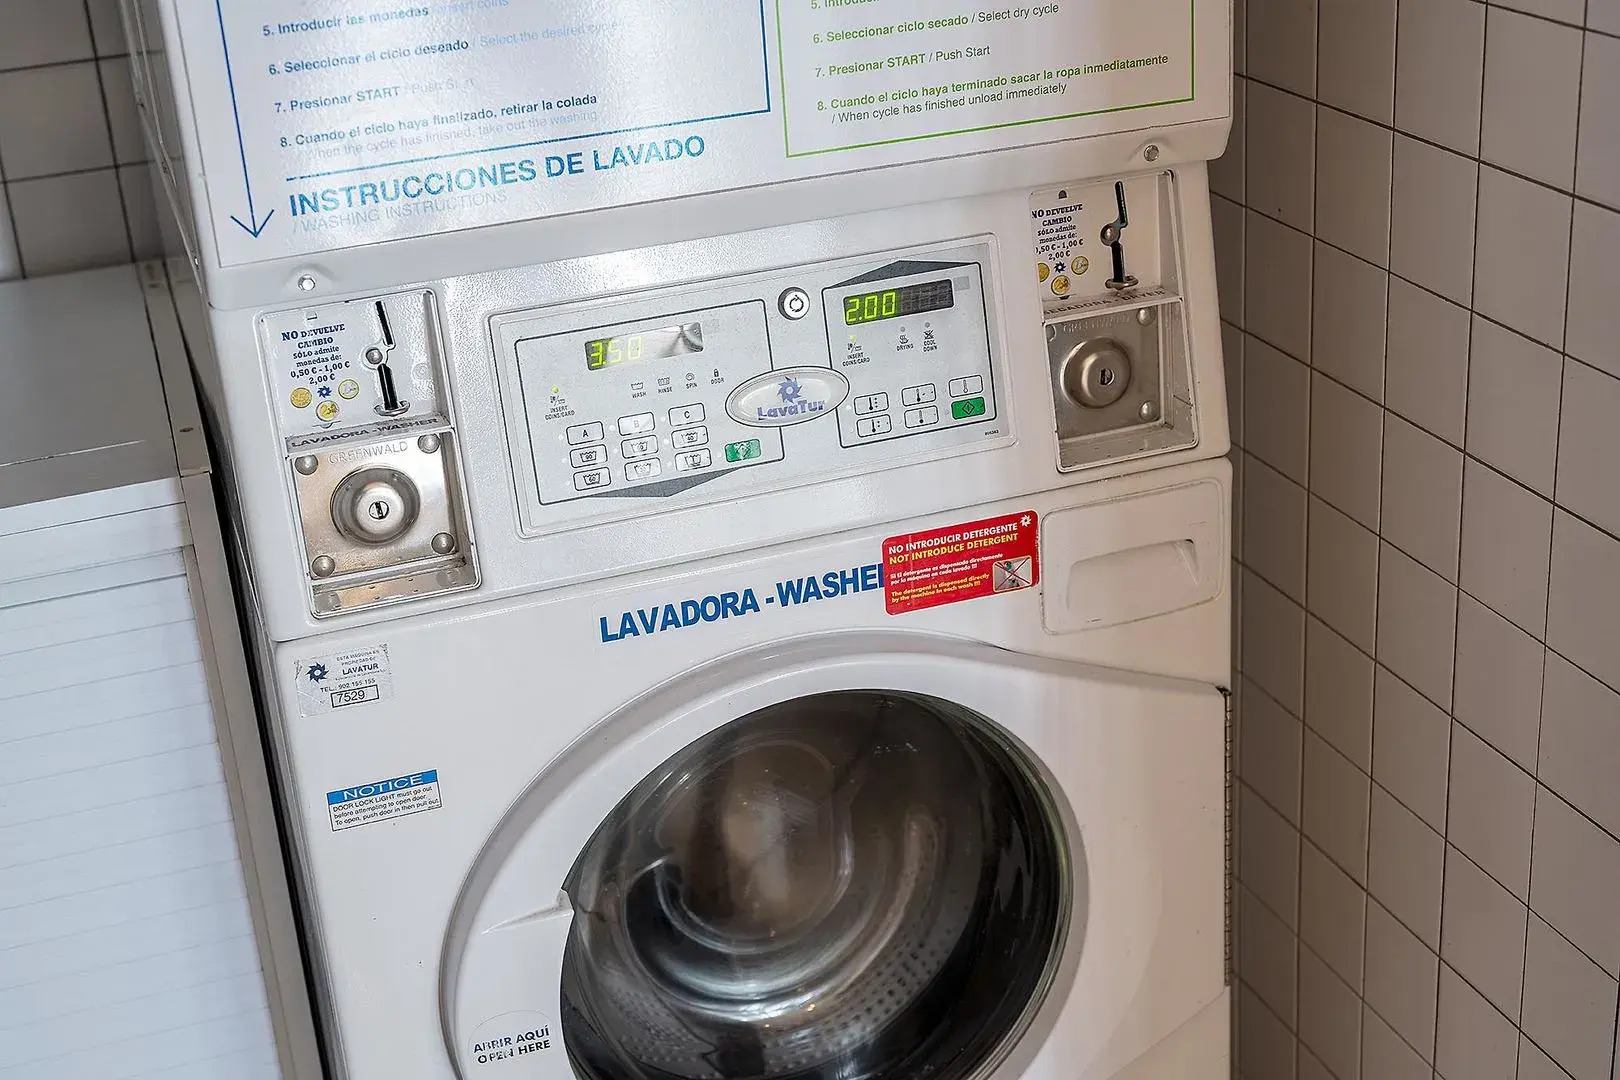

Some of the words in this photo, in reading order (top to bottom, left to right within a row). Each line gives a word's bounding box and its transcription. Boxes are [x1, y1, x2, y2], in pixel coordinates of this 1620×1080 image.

[263, 25, 275, 36] 5.
[278, 17, 342, 34] Introducir
[346, 14, 364, 26] las
[369, 6, 428, 23] monedas
[813, 34, 822, 44] 6.
[827, 25, 894, 42] Seleccionar
[898, 20, 924, 33] ciclo
[928, 14, 968, 29] secado
[978, 8, 1010, 22] Select
[1014, 7, 1030, 19] dry
[1032, 3, 1059, 18] cycle
[268, 65, 280, 75] 6.
[284, 54, 360, 74] Seleccionar
[365, 52, 376, 62] el
[380, 46, 410, 60] ciclo
[414, 39, 468, 56] deseado
[480, 32, 518, 48] Select
[816, 68, 825, 78] 7.
[828, 59, 884, 76] Presionar
[887, 54, 926, 68] START
[936, 50, 962, 62] Push
[966, 45, 990, 58] Start
[818, 101, 827, 110] 8.
[830, 94, 874, 109] Cuando
[878, 92, 888, 102] el
[892, 88, 918, 100] ciclo
[922, 84, 948, 97] haya
[952, 77, 1008, 92] terminado
[1010, 72, 1040, 84] sacar
[1044, 70, 1053, 80] la
[1056, 66, 1080, 79] ropa
[1084, 54, 1168, 74] inmediatamente
[274, 102, 286, 113] 7.
[290, 95, 352, 112] Presionar
[356, 86, 400, 102] START
[839, 110, 869, 122] When
[873, 105, 900, 120] cycle
[903, 102, 922, 114] has
[925, 96, 965, 111] finished
[968, 92, 1002, 105] unload
[1006, 82, 1066, 99] immediately
[280, 136, 292, 148] 8.
[295, 130, 345, 145] Cuando
[350, 127, 360, 138] el
[364, 122, 394, 136] ciclo
[399, 117, 428, 131] haya
[432, 109, 497, 124] finalizado,
[501, 102, 538, 116] retirar
[542, 100, 554, 110] la
[556, 95, 597, 109] colada
[366, 138, 396, 153] cycle
[400, 134, 422, 146] has
[506, 121, 526, 132] out
[290, 160, 536, 216] INSTRUCCIONES
[546, 152, 584, 178] DE
[593, 135, 706, 171] LAVADO
[300, 210, 380, 232] WASHING
[385, 191, 508, 218] INSTRUCTIONS
[1032, 209, 1044, 218] NO
[1046, 204, 1082, 216] DEVUELVE
[1038, 226, 1054, 236] SÓLO
[1055, 224, 1076, 234] admite
[1042, 216, 1072, 226] CAMBIO
[1040, 234, 1066, 244] monedas
[1062, 240, 1078, 250] 1,00
[1048, 252, 1064, 260] 2,00
[847, 292, 896, 324] 2.00
[282, 330, 298, 341] NO
[301, 324, 346, 338] DEVUELVE
[298, 336, 334, 349] CAMBIO
[896, 343, 914, 352] DRYING
[293, 350, 312, 360] SÓLO
[314, 346, 340, 356] admite
[296, 358, 329, 368] monedas
[330, 355, 342, 364] de:
[842, 358, 870, 366] COINS/CARD
[847, 352, 864, 360] INSERT
[290, 368, 310, 379] 0,50
[311, 366, 317, 374] €
[325, 362, 344, 373] 1,00
[344, 360, 350, 368] €
[308, 374, 328, 385] 2,00
[330, 373, 336, 381] €
[632, 391, 647, 399] WASH
[658, 386, 673, 394] RINSE
[686, 382, 698, 390] SPIN
[550, 405, 568, 414] INSERT
[684, 410, 690, 420] C
[757, 399, 826, 420] LavaTur
[292, 428, 370, 448] LAVADORA
[582, 430, 588, 438] A
[328, 440, 408, 464] GREENWALD
[888, 544, 904, 555] NO
[906, 534, 962, 552] INTRODUCIR
[963, 523, 1018, 540] DETERGENTE
[889, 554, 910, 564] NOT
[912, 544, 964, 560] INTRODUCE
[967, 532, 1018, 550] DETERGENT
[903, 585, 932, 594] detergent
[938, 577, 968, 588] dispensed
[968, 573, 990, 582] directly
[911, 590, 936, 598] machine
[600, 588, 760, 643] LAVADORA
[342, 662, 379, 675] LAVATUR
[337, 690, 366, 703] 7529
[344, 774, 424, 800] NOTICE
[333, 804, 354, 812] DOOR
[354, 799, 374, 808] LOCK
[375, 794, 395, 802] LIGHT
[334, 810, 354, 820] before
[354, 804, 387, 816] attempting
[396, 798, 408, 806] open
[362, 812, 378, 822] push
[401, 804, 416, 812] then
[416, 800, 428, 808] pull
[474, 1036, 512, 1054] ABRIR
[516, 1024, 550, 1043] AQUÍ
[478, 1048, 514, 1064] OPEN
[518, 1040, 550, 1056] HERE
